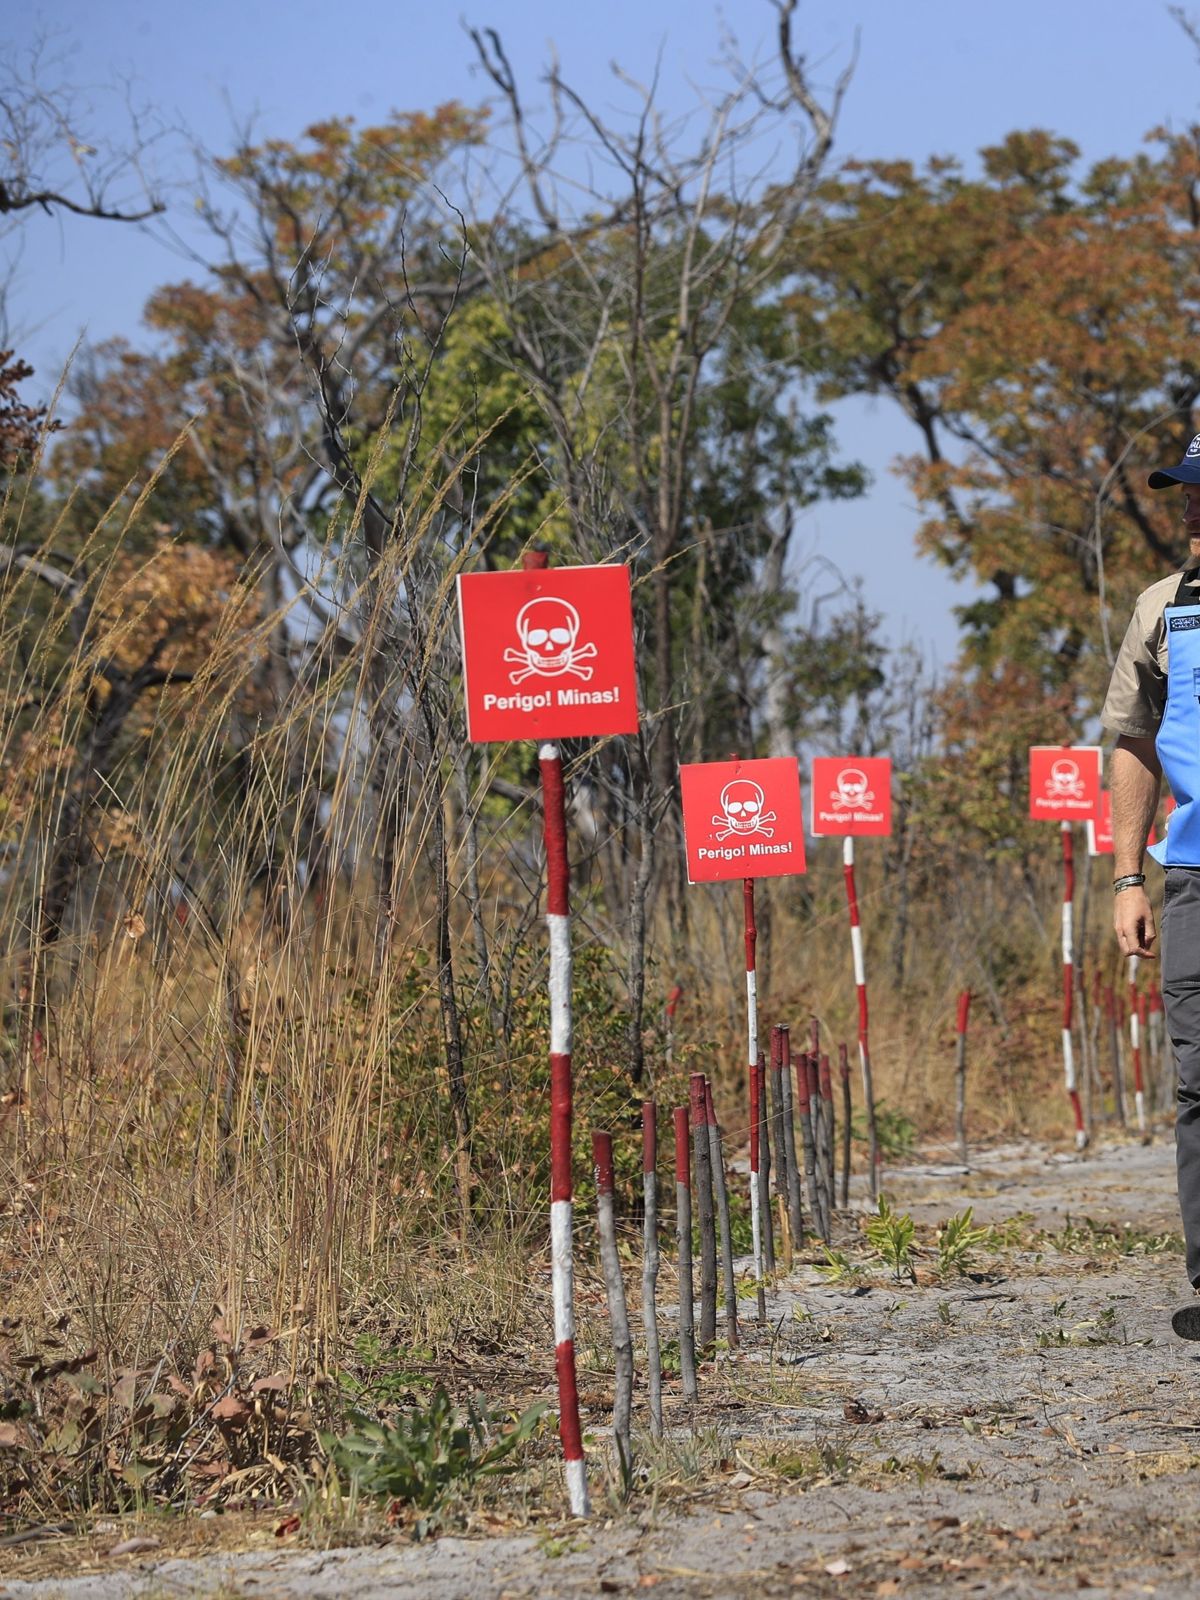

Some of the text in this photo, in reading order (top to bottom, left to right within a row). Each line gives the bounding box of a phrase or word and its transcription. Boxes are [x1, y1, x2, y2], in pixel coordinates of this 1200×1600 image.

[483, 687, 620, 712] Perigo! Minas!
[819, 812, 884, 823] Perigo! Minas!
[698, 842, 793, 859] Perigo! Minas!
